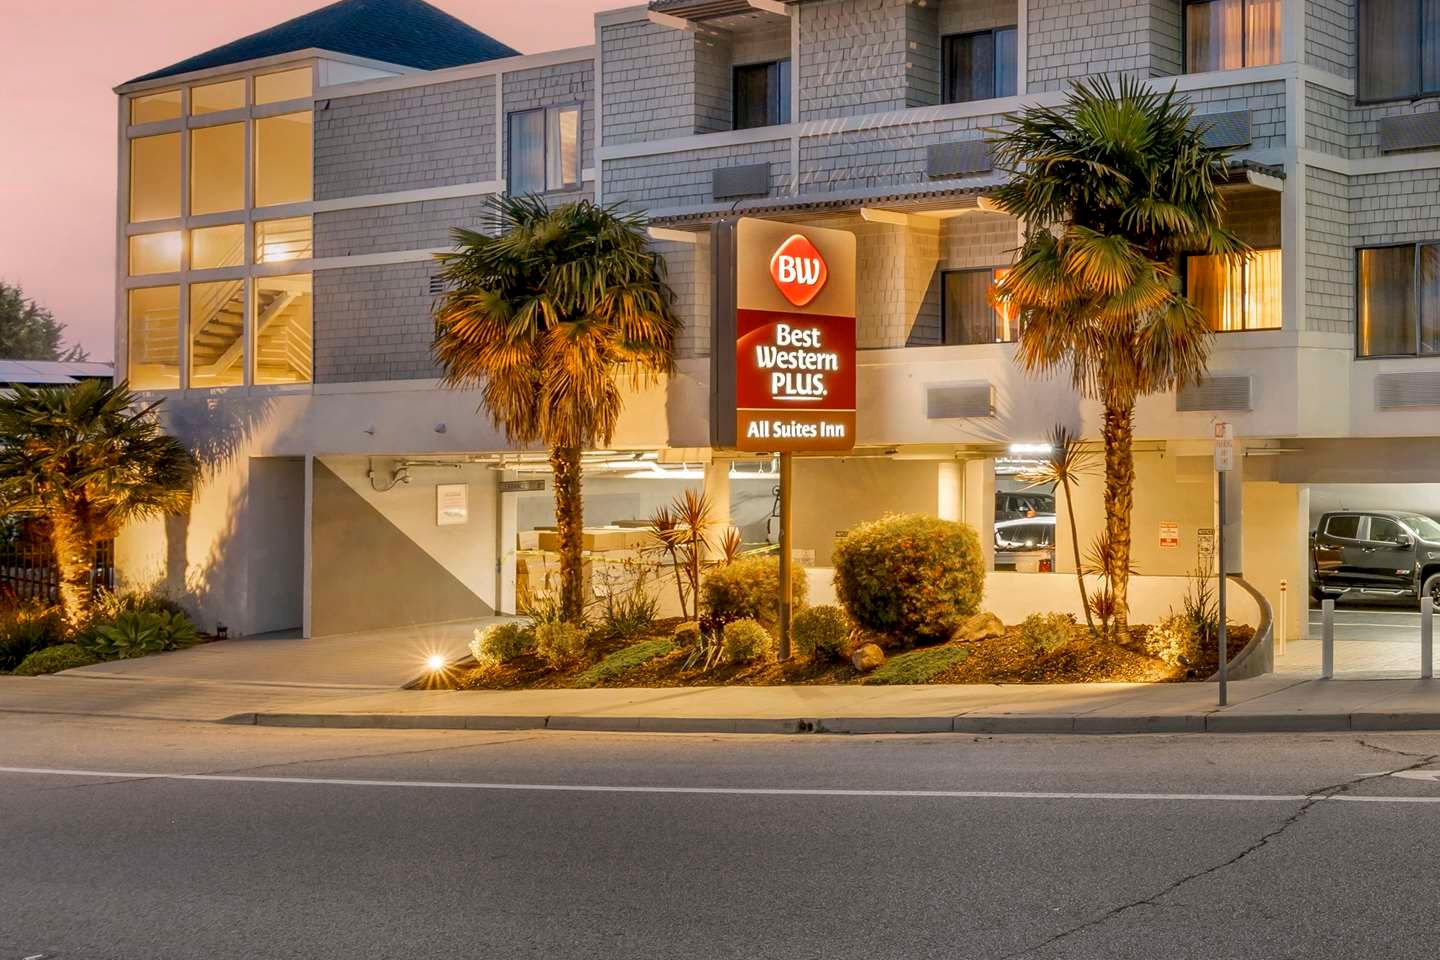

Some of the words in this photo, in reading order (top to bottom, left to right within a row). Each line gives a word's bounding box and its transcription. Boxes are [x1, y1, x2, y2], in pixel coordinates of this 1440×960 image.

[778, 255, 820, 286] BW
[776, 323, 821, 348] Best
[756, 345, 838, 371] Western
[747, 421, 769, 437] All
[773, 421, 817, 437] Suites
[820, 422, 845, 437] Inn
